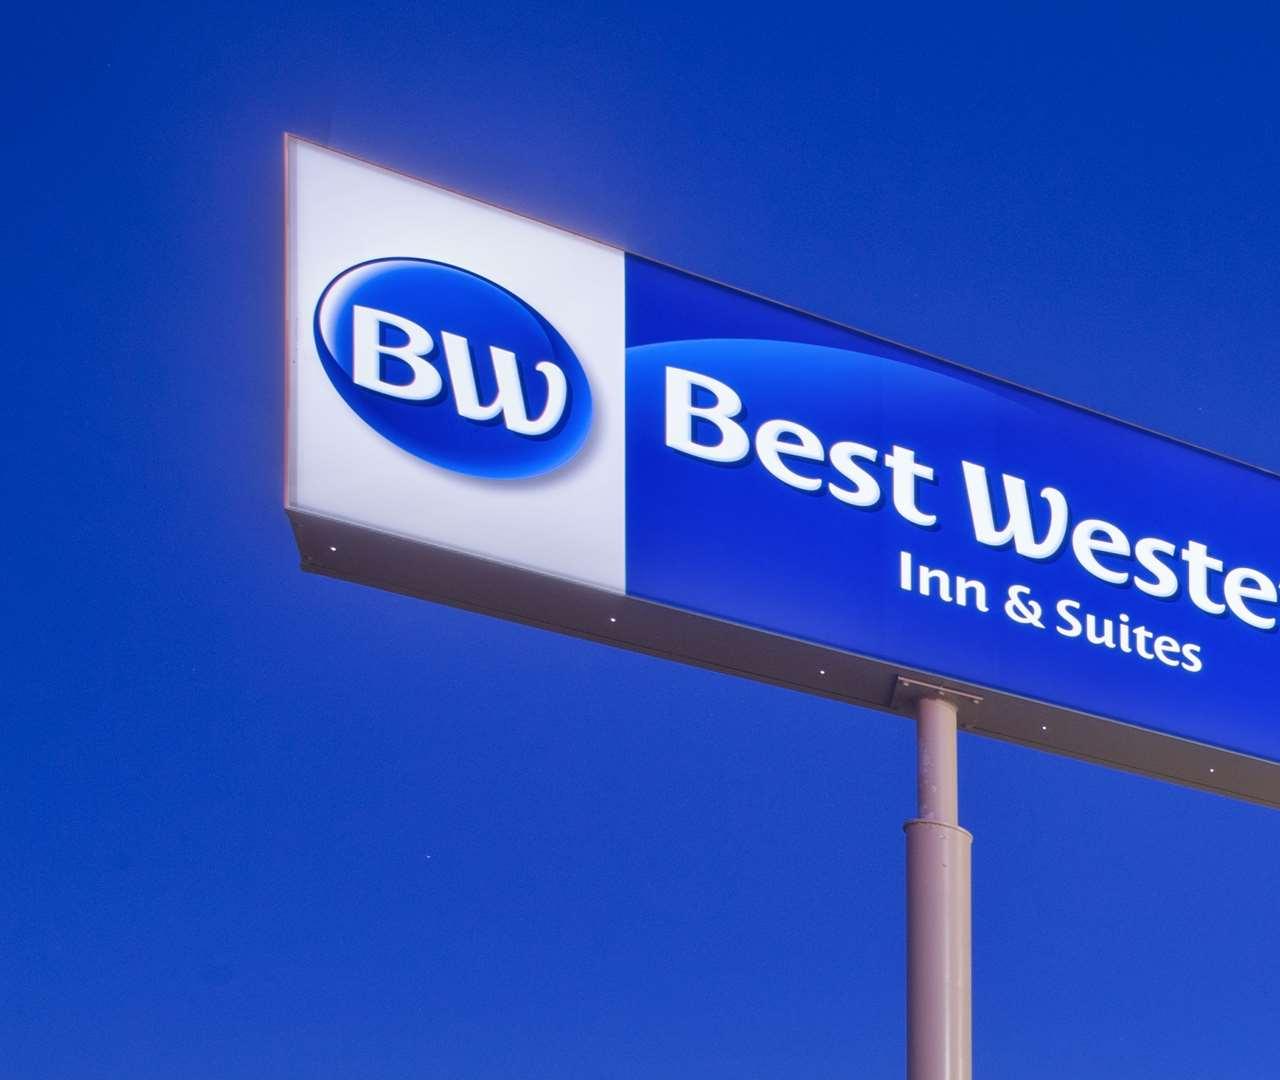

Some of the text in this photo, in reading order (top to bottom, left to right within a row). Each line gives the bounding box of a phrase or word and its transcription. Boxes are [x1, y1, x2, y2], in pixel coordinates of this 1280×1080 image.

[353, 305, 568, 437] BW
[665, 366, 938, 527] Best
[899, 551, 1203, 674] Inn & Suites
